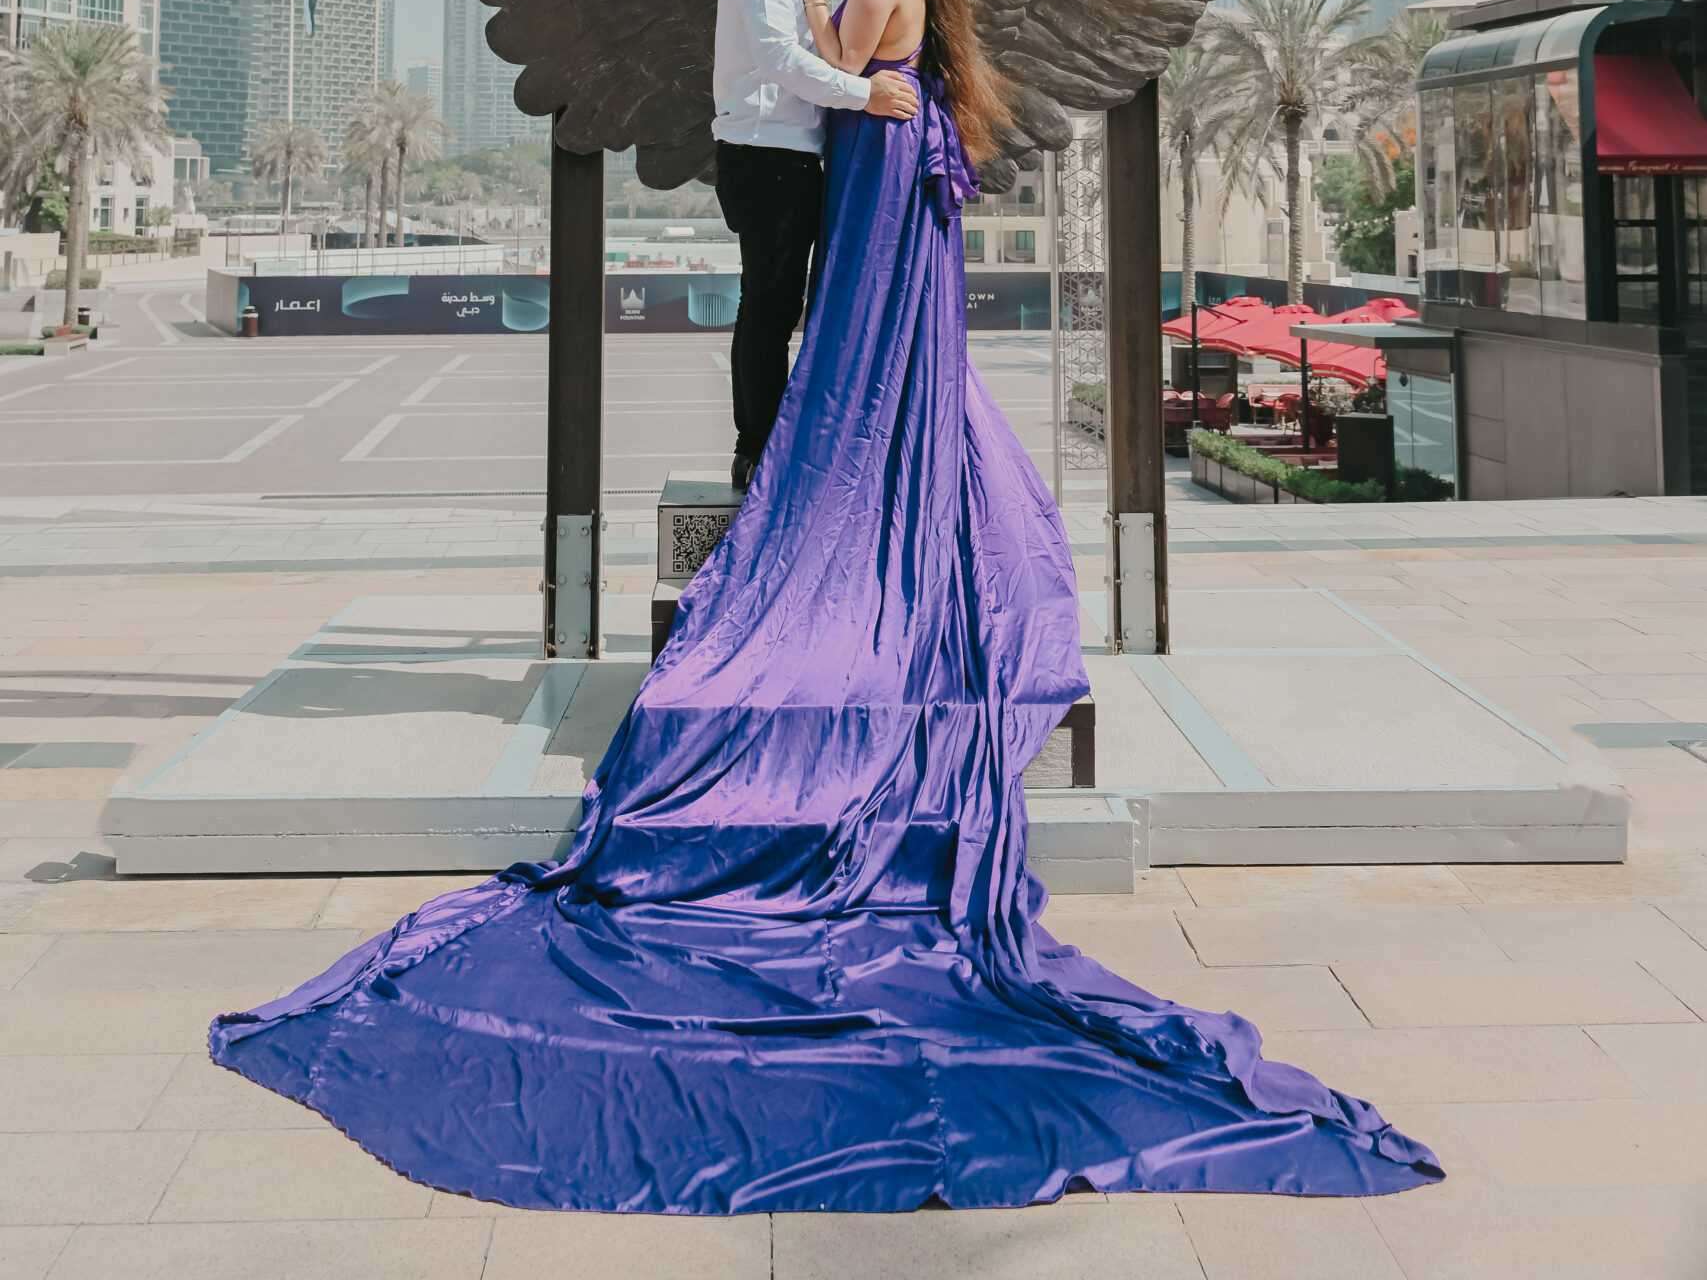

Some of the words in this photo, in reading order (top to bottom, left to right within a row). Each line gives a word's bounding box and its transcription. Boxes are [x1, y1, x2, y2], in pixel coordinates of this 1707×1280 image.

[441, 291, 468, 304] مدينة
[470, 291, 495, 305] وسط
[456, 307, 480, 318] دبي
